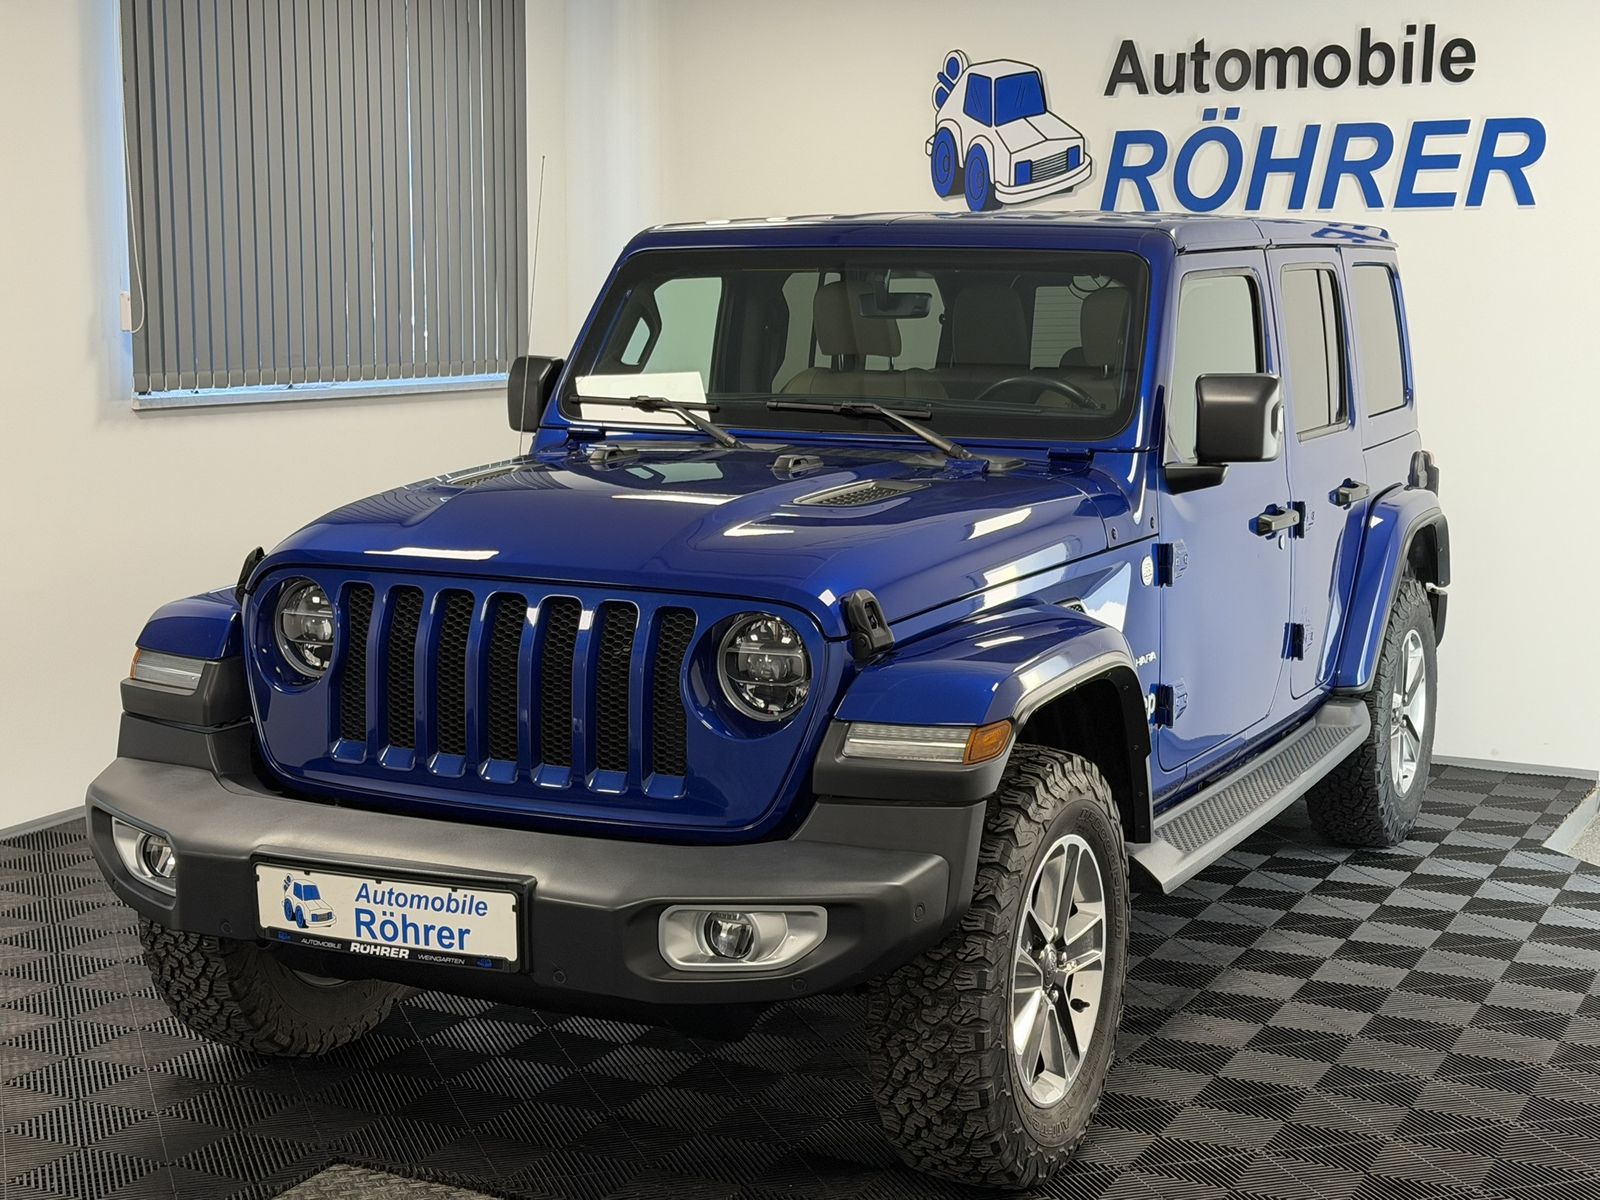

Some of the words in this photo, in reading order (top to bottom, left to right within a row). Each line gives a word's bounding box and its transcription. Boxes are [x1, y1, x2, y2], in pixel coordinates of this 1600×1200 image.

[1104, 23, 1477, 97] Automobile
[1100, 107, 1547, 211] RÖHRER
[355, 883, 487, 916] Automobile
[355, 908, 471, 950] Röhrer
[301, 938, 342, 949] AUTOMOBILE
[350, 942, 410, 959] RÖHRER
[417, 954, 465, 965] WEINGARTEN
